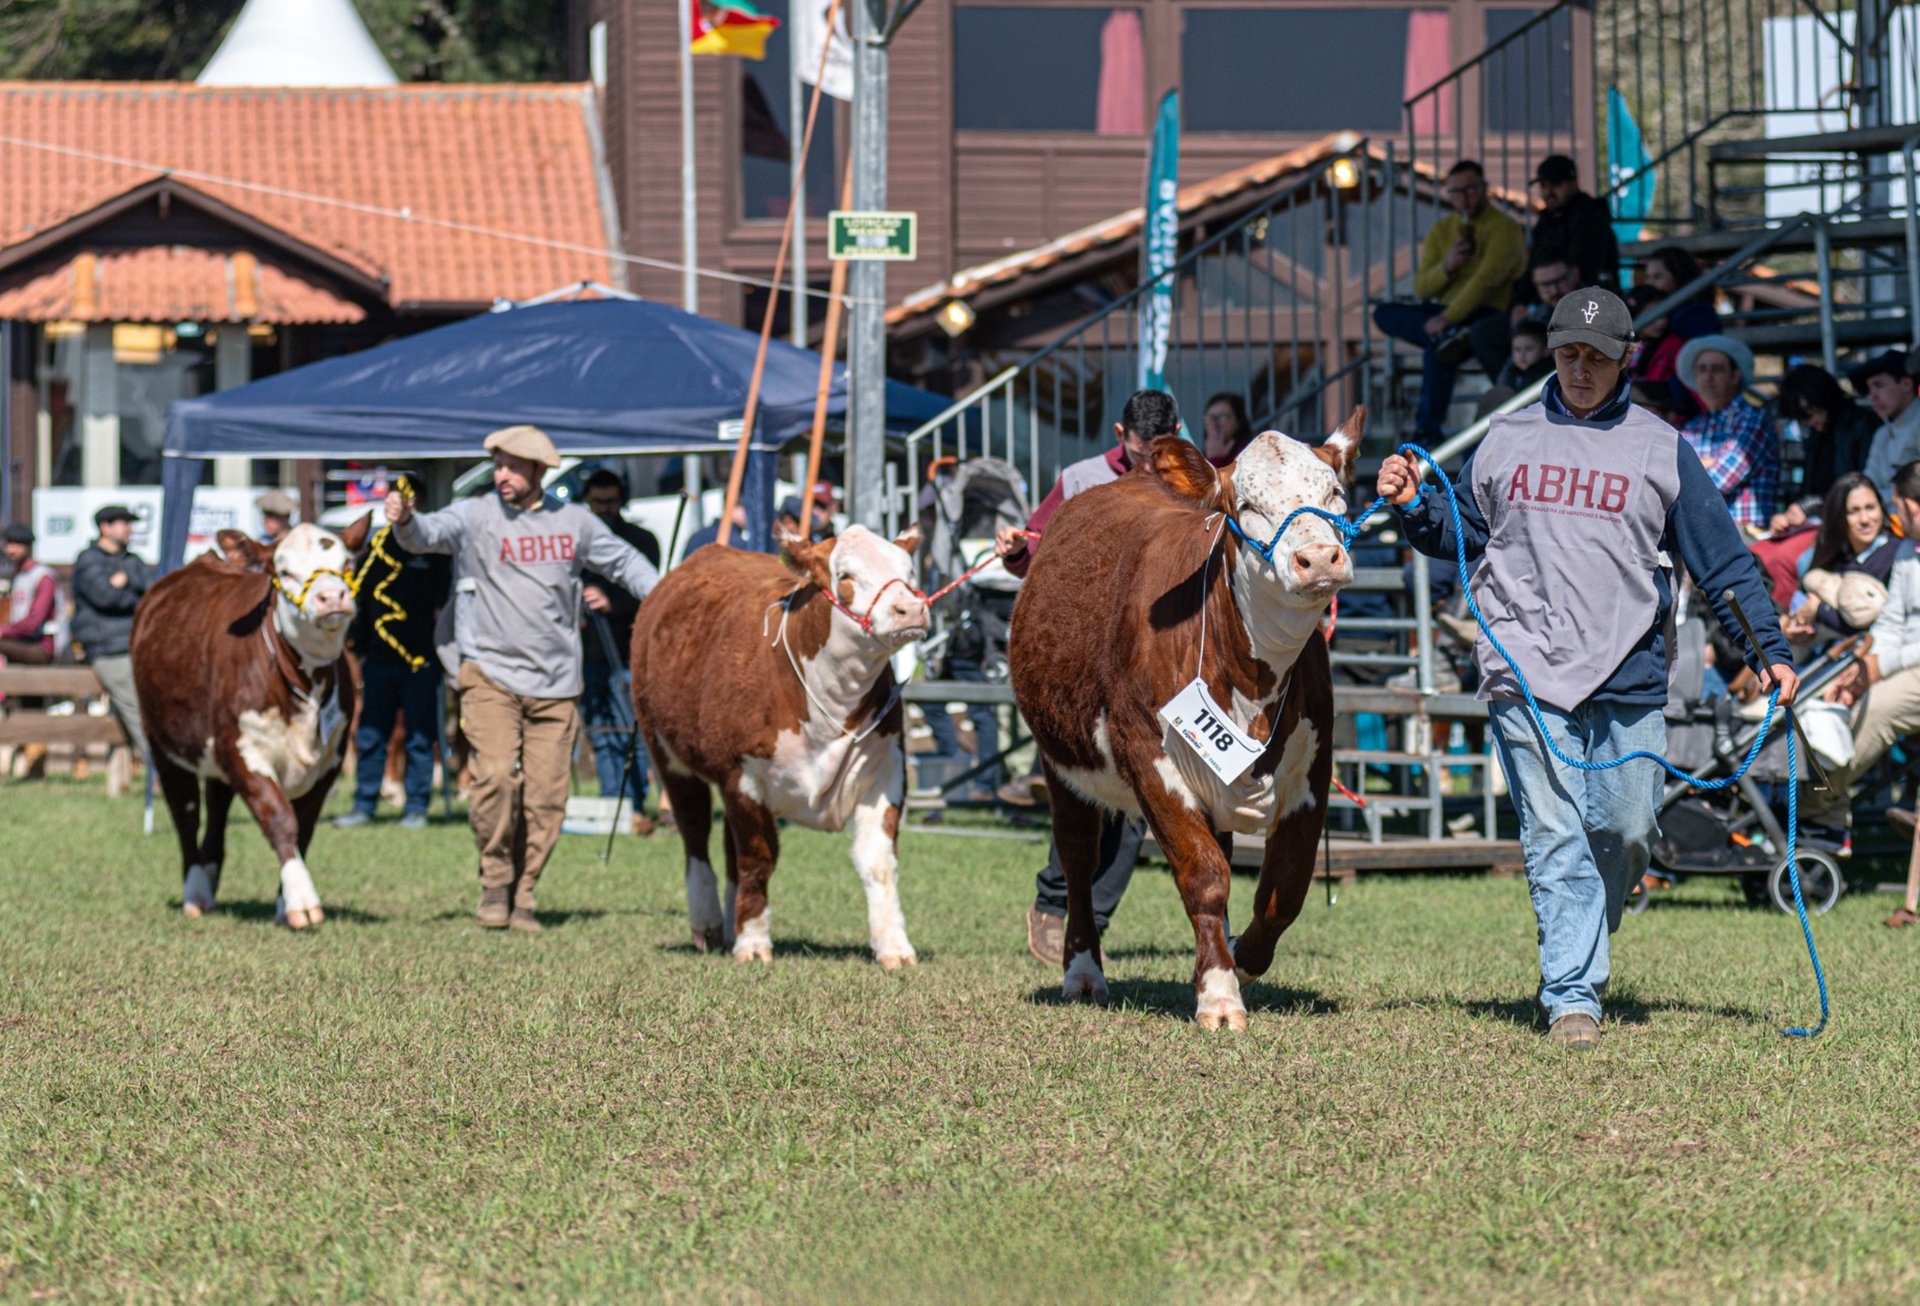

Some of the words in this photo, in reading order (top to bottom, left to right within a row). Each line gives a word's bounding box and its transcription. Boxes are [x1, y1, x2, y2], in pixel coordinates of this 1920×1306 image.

[1507, 463, 1630, 514] ABHB
[499, 534, 575, 562] ABHB
[1193, 708, 1234, 752] 1118
